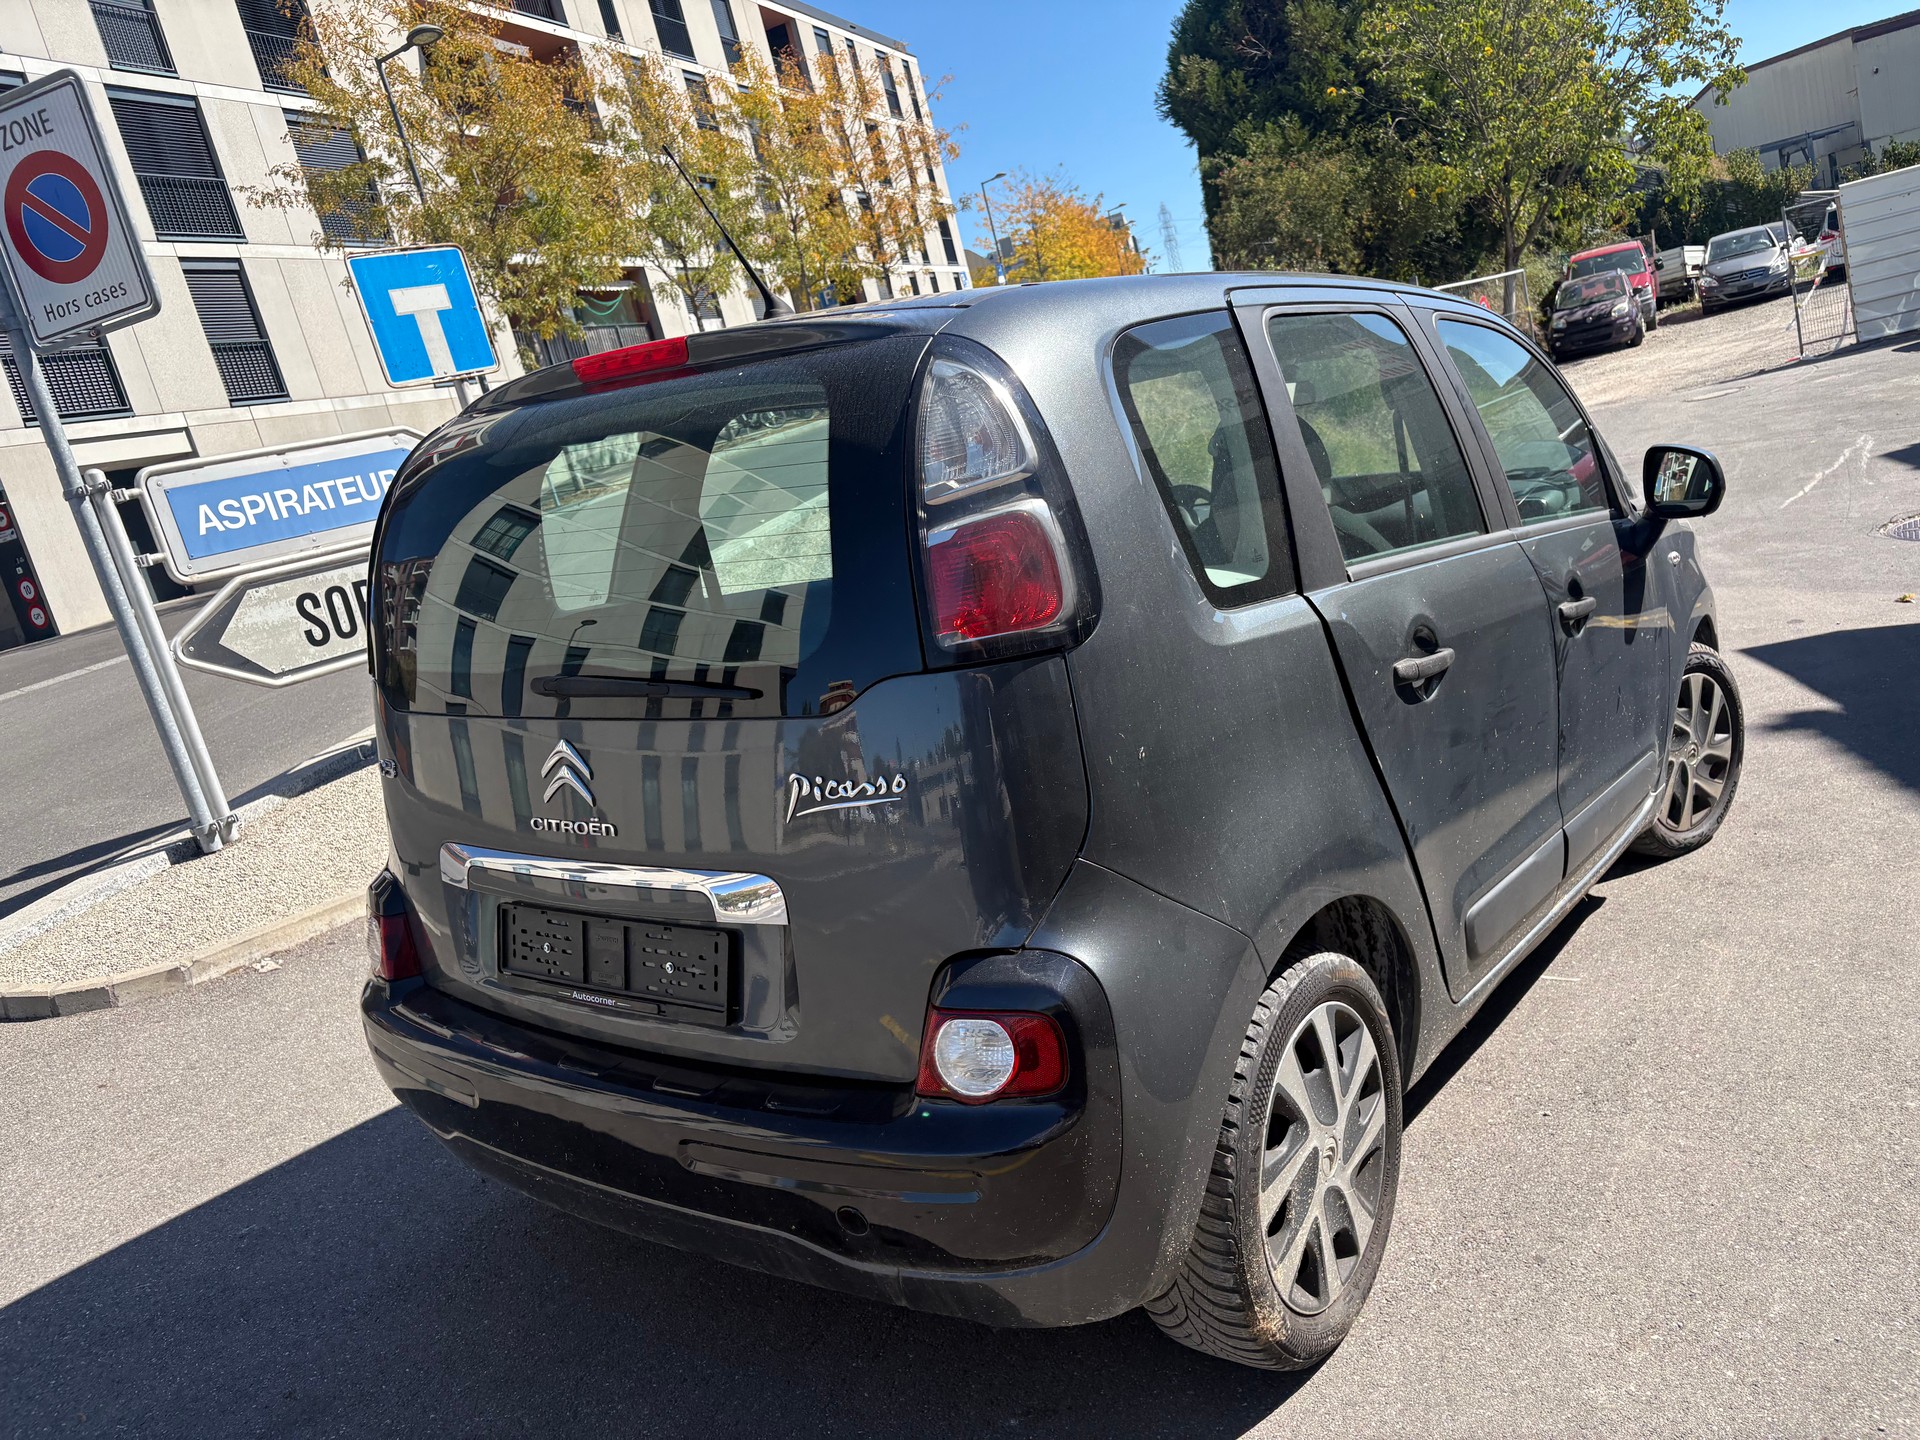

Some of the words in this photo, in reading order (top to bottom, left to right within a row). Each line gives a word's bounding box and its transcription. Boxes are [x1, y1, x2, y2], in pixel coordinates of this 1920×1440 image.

[0, 108, 54, 151] ZONE
[44, 298, 81, 322] Hors
[85, 281, 127, 308] cases
[787, 773, 907, 824] Picasso
[572, 990, 616, 1006] Autocorner
